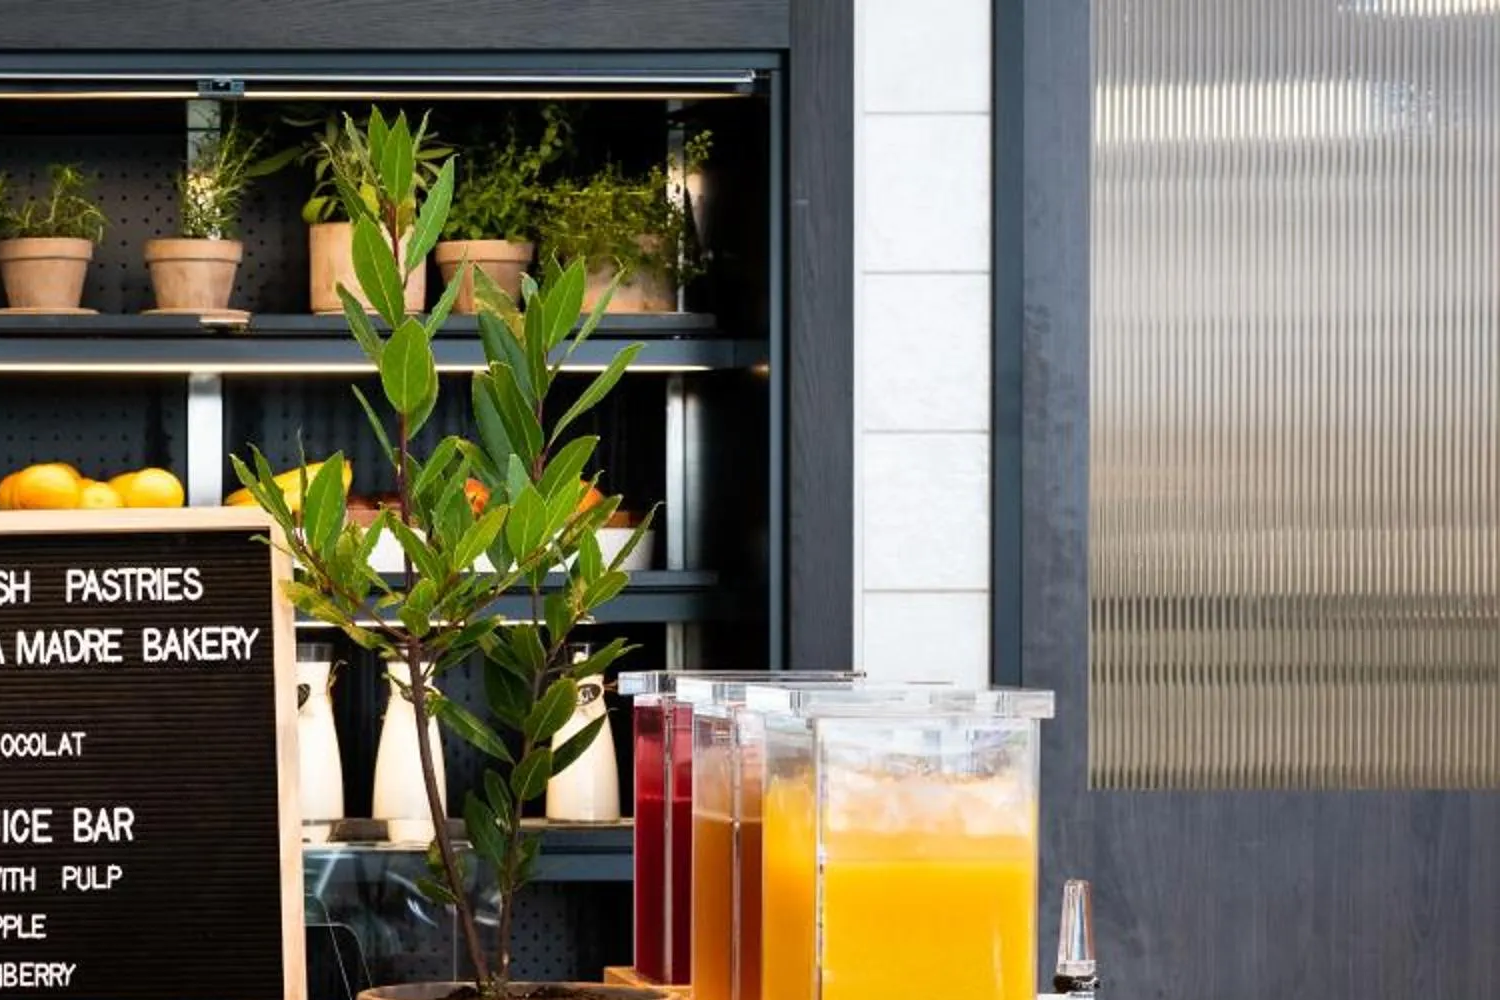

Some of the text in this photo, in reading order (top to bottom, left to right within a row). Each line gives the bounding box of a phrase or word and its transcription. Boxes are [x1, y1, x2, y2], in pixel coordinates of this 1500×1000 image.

[65, 567, 204, 604] PASTRIES
[15, 627, 124, 666] MADRE
[142, 625, 260, 663] BAKERY
[72, 806, 135, 843] BAR
[61, 863, 123, 892] PULP
